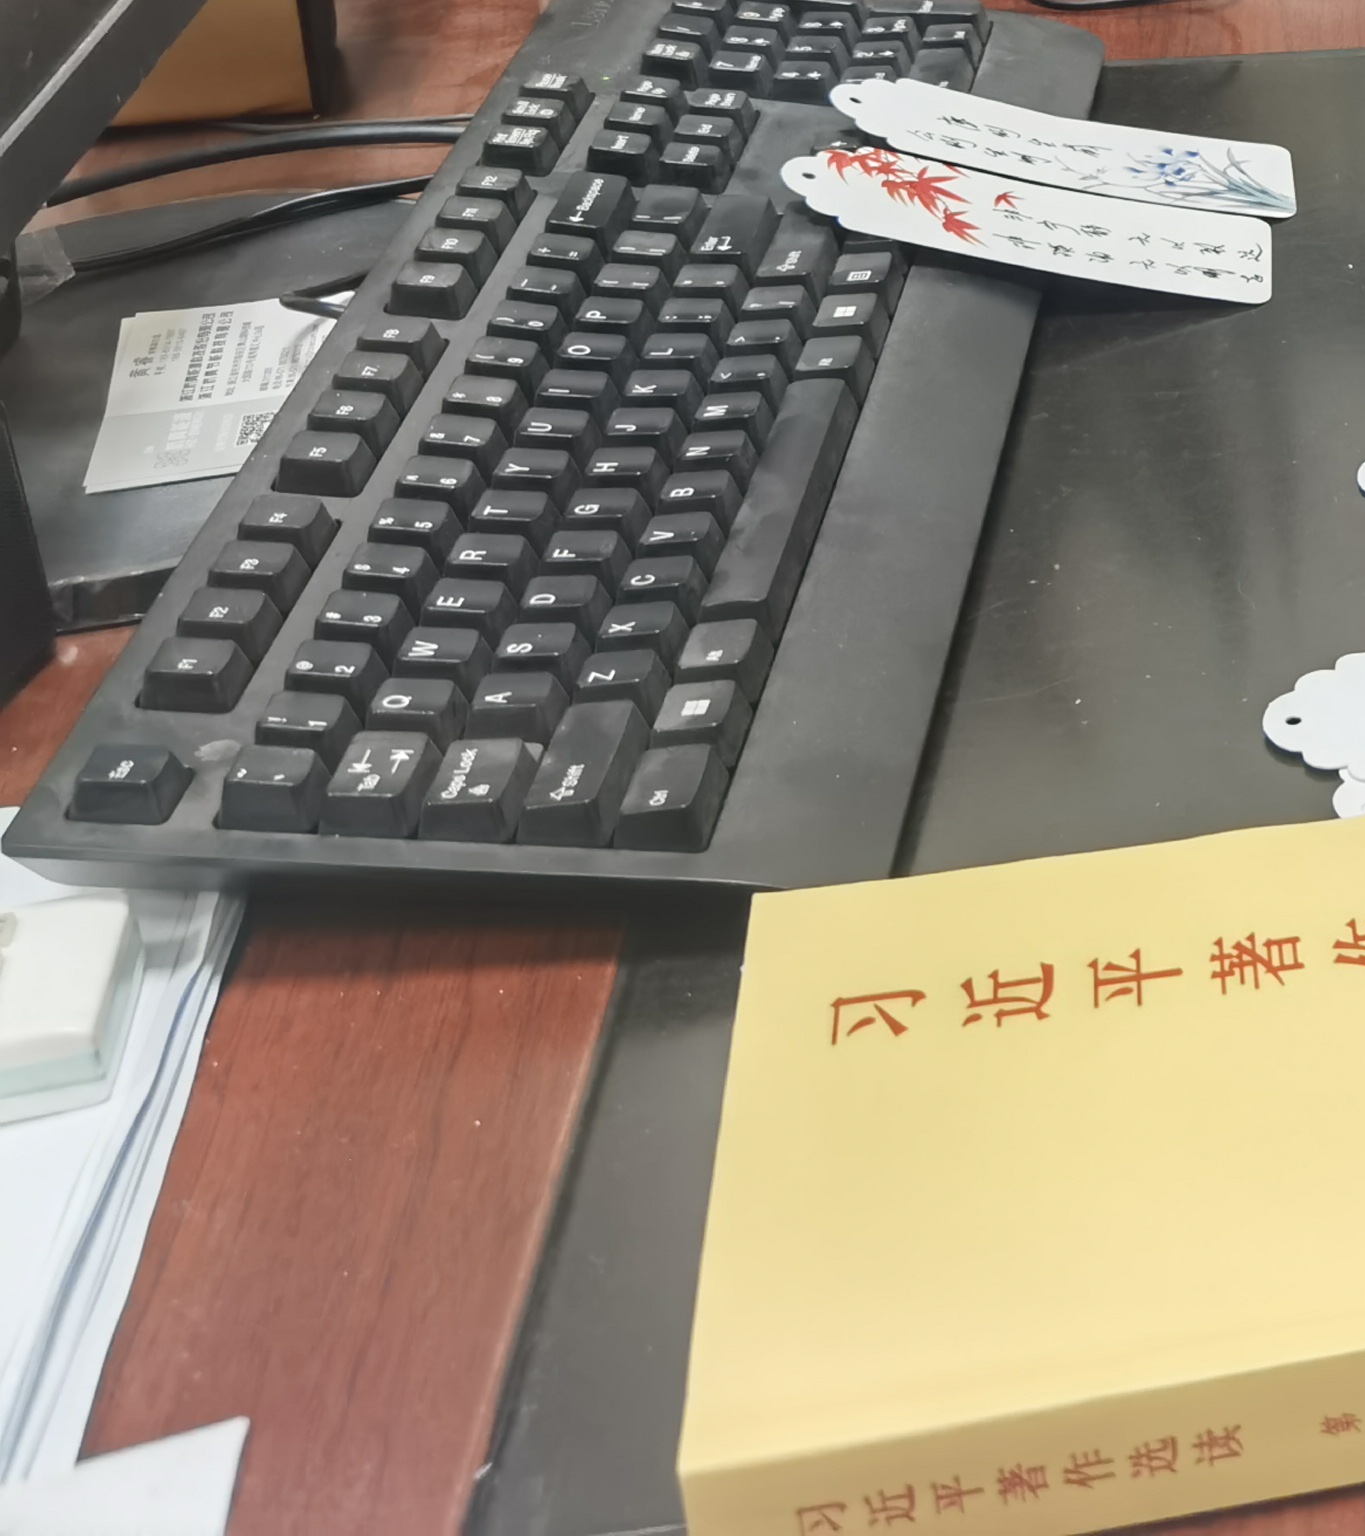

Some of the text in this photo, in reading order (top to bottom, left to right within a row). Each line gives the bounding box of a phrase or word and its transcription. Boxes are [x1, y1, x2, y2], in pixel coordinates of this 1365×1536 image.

[481, 175, 498, 186] F12
[576, 178, 604, 211] Backspace
[585, 310, 607, 319] P
[567, 345, 591, 355] O
[650, 347, 673, 355] L
[361, 366, 379, 376] F7
[632, 385, 657, 393] K
[703, 405, 729, 417] M
[527, 421, 552, 433] U
[615, 424, 636, 432] J
[463, 435, 481, 444] 7
[309, 446, 328, 458] F5
[685, 445, 711, 457] N
[504, 463, 530, 473] Y
[593, 462, 619, 473] H
[440, 477, 457, 485] 6
[670, 486, 695, 498] B
[483, 505, 508, 515] T
[574, 504, 600, 515] G
[269, 511, 288, 524] F4
[414, 521, 433, 529] 5
[650, 530, 675, 541] V
[459, 549, 487, 561] R
[553, 548, 576, 558] F
[392, 566, 411, 575] 4
[630, 574, 656, 586] C
[436, 596, 465, 608] E
[529, 593, 556, 605] D
[209, 606, 229, 619] F2
[363, 615, 382, 623] 3
[608, 621, 636, 633] X
[408, 640, 438, 657] W
[507, 643, 533, 654] S
[177, 659, 198, 670] F1
[335, 665, 356, 673] 2
[588, 669, 615, 684] Z
[382, 695, 412, 708] Q
[485, 691, 512, 703] A
[108, 760, 134, 779] Esc
[440, 748, 478, 799] Caps Lock
[796, 1424, 1244, 1536] 习近平著作选读
